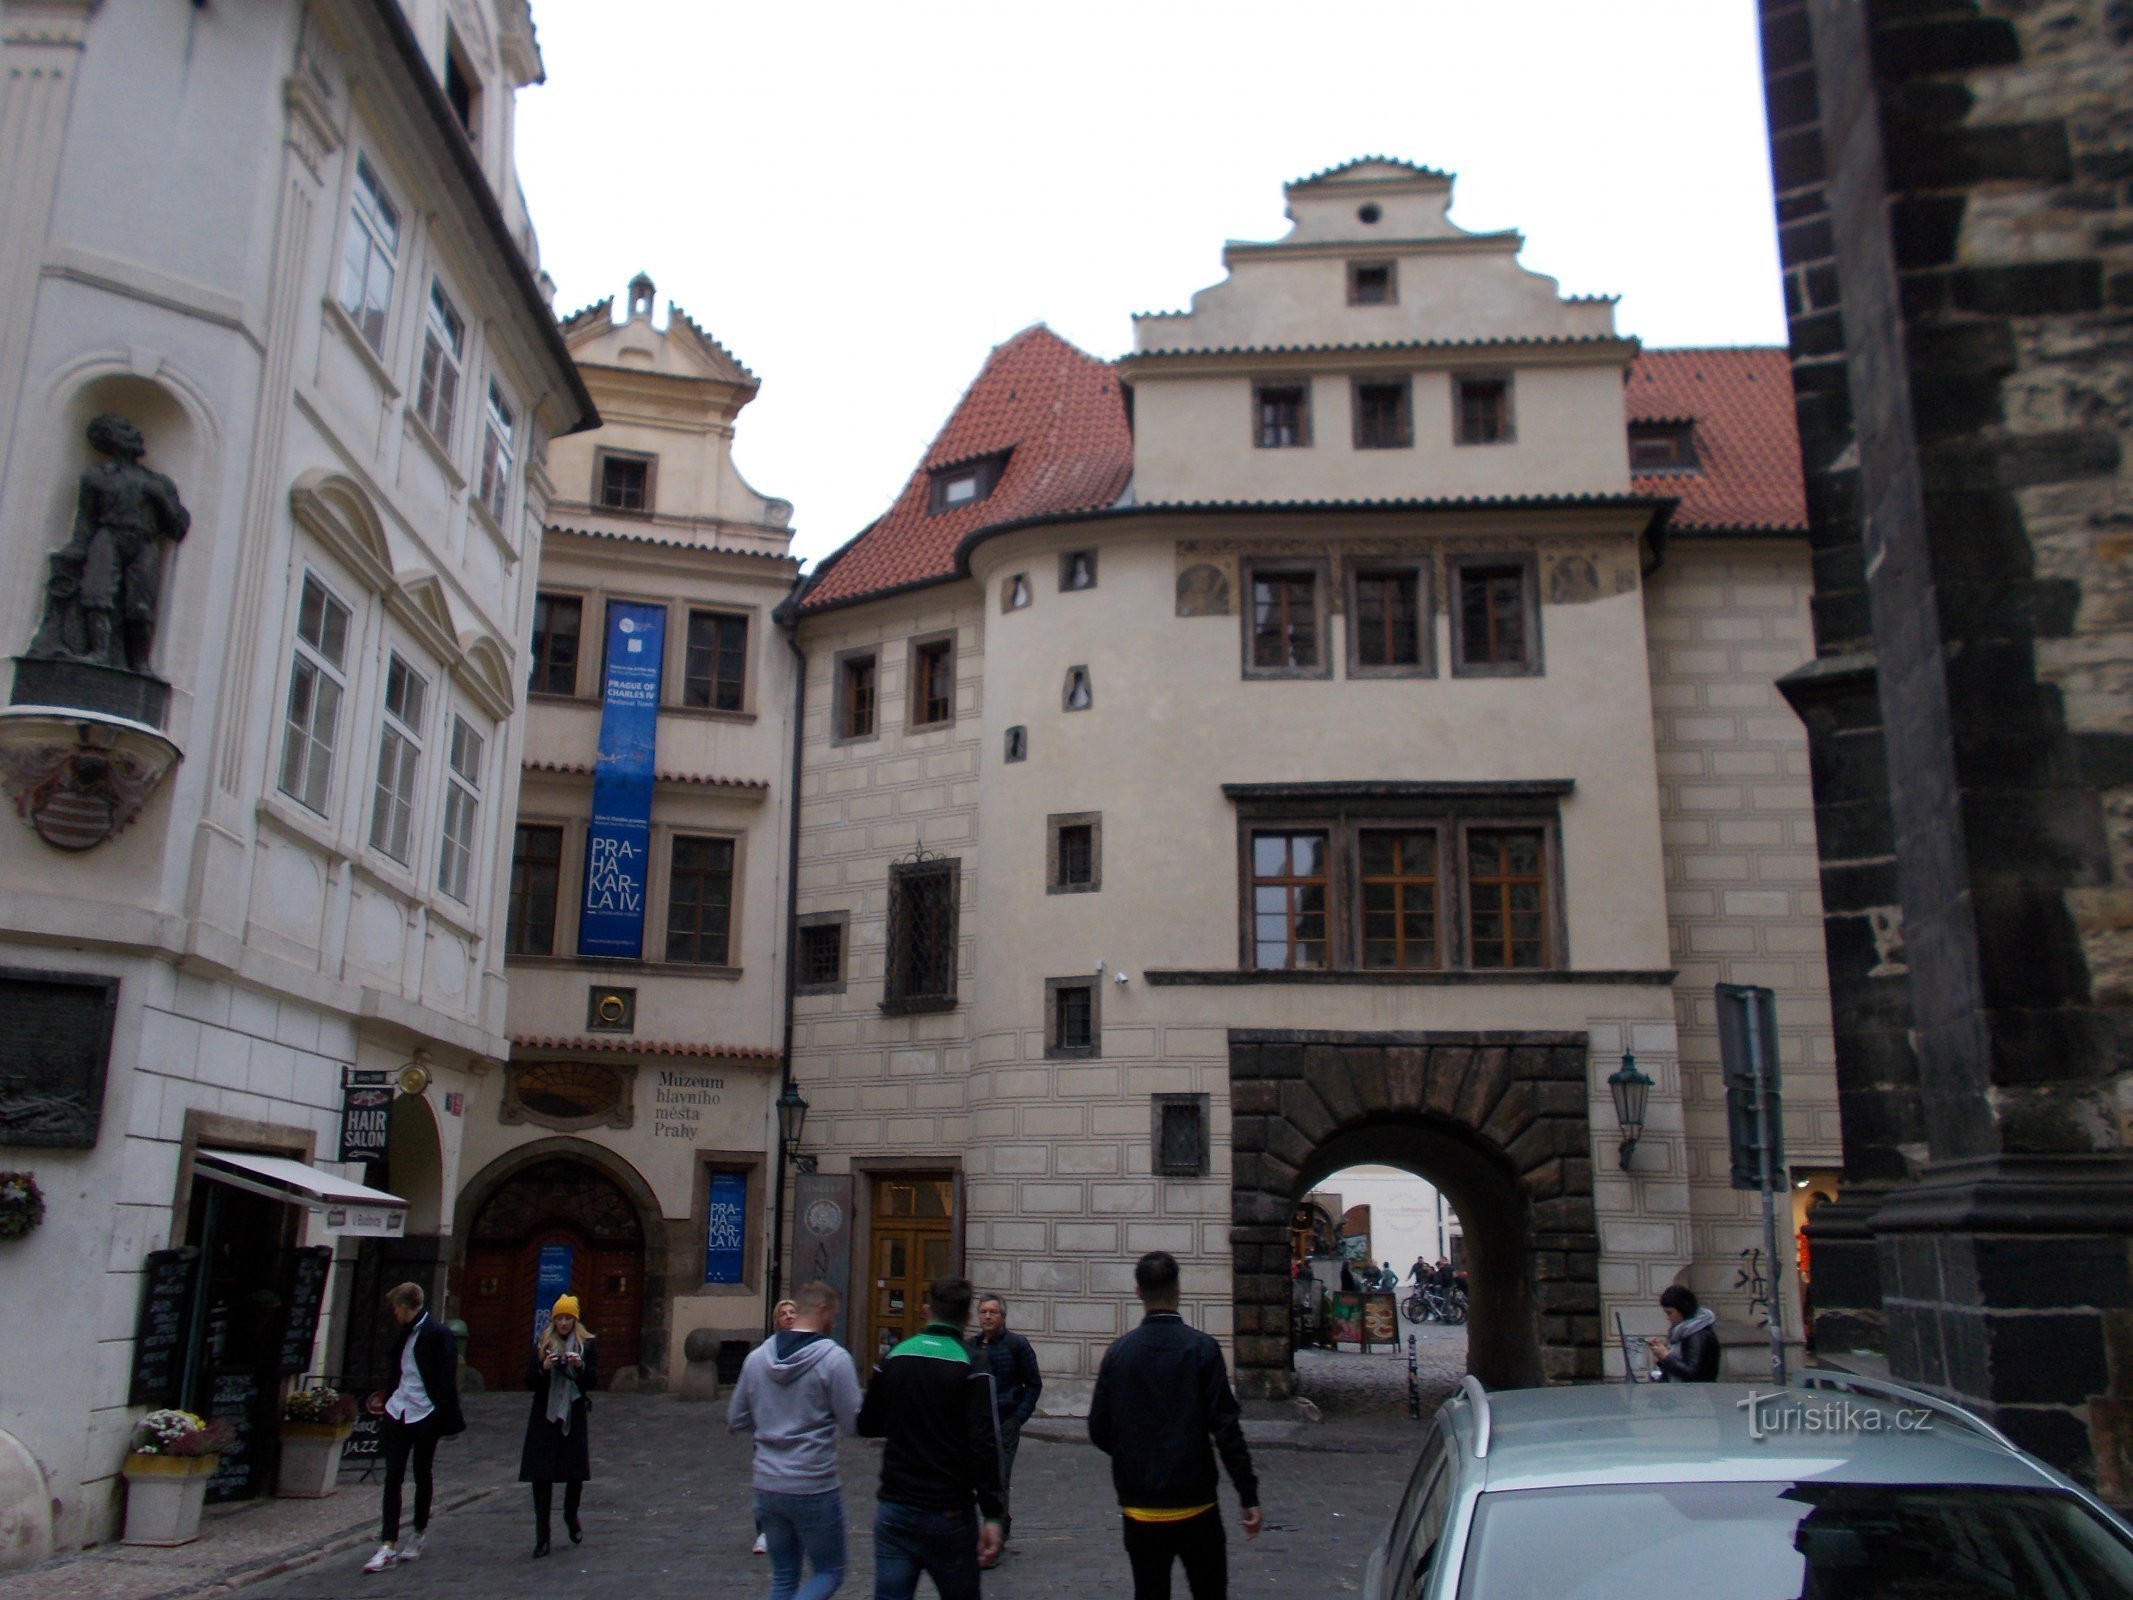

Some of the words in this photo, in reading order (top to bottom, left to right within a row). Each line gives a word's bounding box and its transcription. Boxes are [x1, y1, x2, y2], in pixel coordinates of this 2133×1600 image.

[608, 679, 642, 690] PRAGUE
[607, 688, 645, 699] CHARLES
[592, 837, 642, 859] PRA-
[591, 855, 619, 875] HA
[589, 873, 639, 893] KAR-
[587, 891, 614, 910] LA
[620, 892, 640, 911] IV.
[659, 1071, 724, 1088] Muzeum
[656, 1088, 720, 1105] hlavního
[347, 1110, 386, 1131] HAIR
[655, 1106, 700, 1120] města
[345, 1131, 386, 1147] SALON
[655, 1122, 698, 1141] Prahy
[710, 1203, 741, 1214] PRA-
[710, 1214, 728, 1225] HA
[709, 1225, 740, 1236] KAR-
[708, 1236, 725, 1247] LA
[342, 1440, 379, 1456] JAZZ
